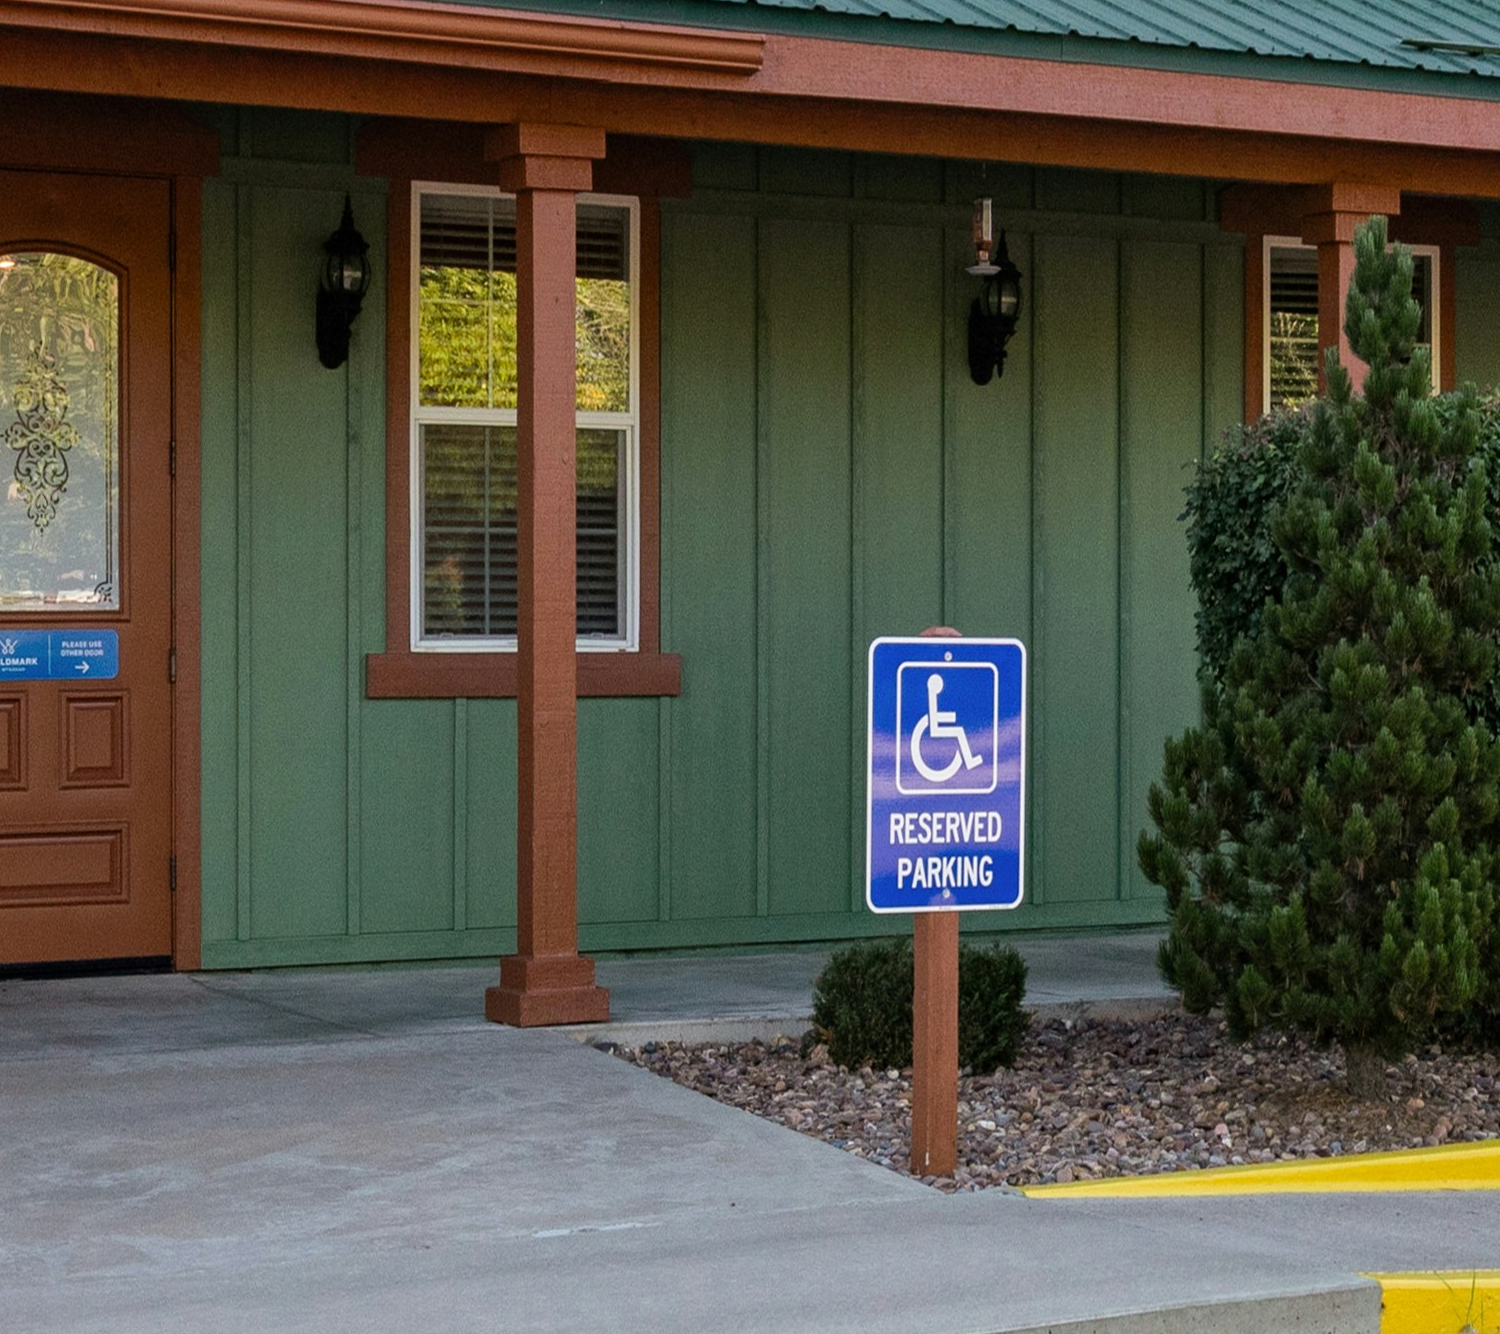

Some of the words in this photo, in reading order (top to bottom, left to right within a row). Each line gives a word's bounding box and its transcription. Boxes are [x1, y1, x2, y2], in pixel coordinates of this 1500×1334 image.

[60, 648, 84, 657] OTHER
[85, 648, 104, 657] DOOR
[61, 640, 87, 649] PLEASE
[88, 640, 102, 648] USE
[889, 811, 1002, 845] RESERVED
[897, 855, 994, 889] PARKING
